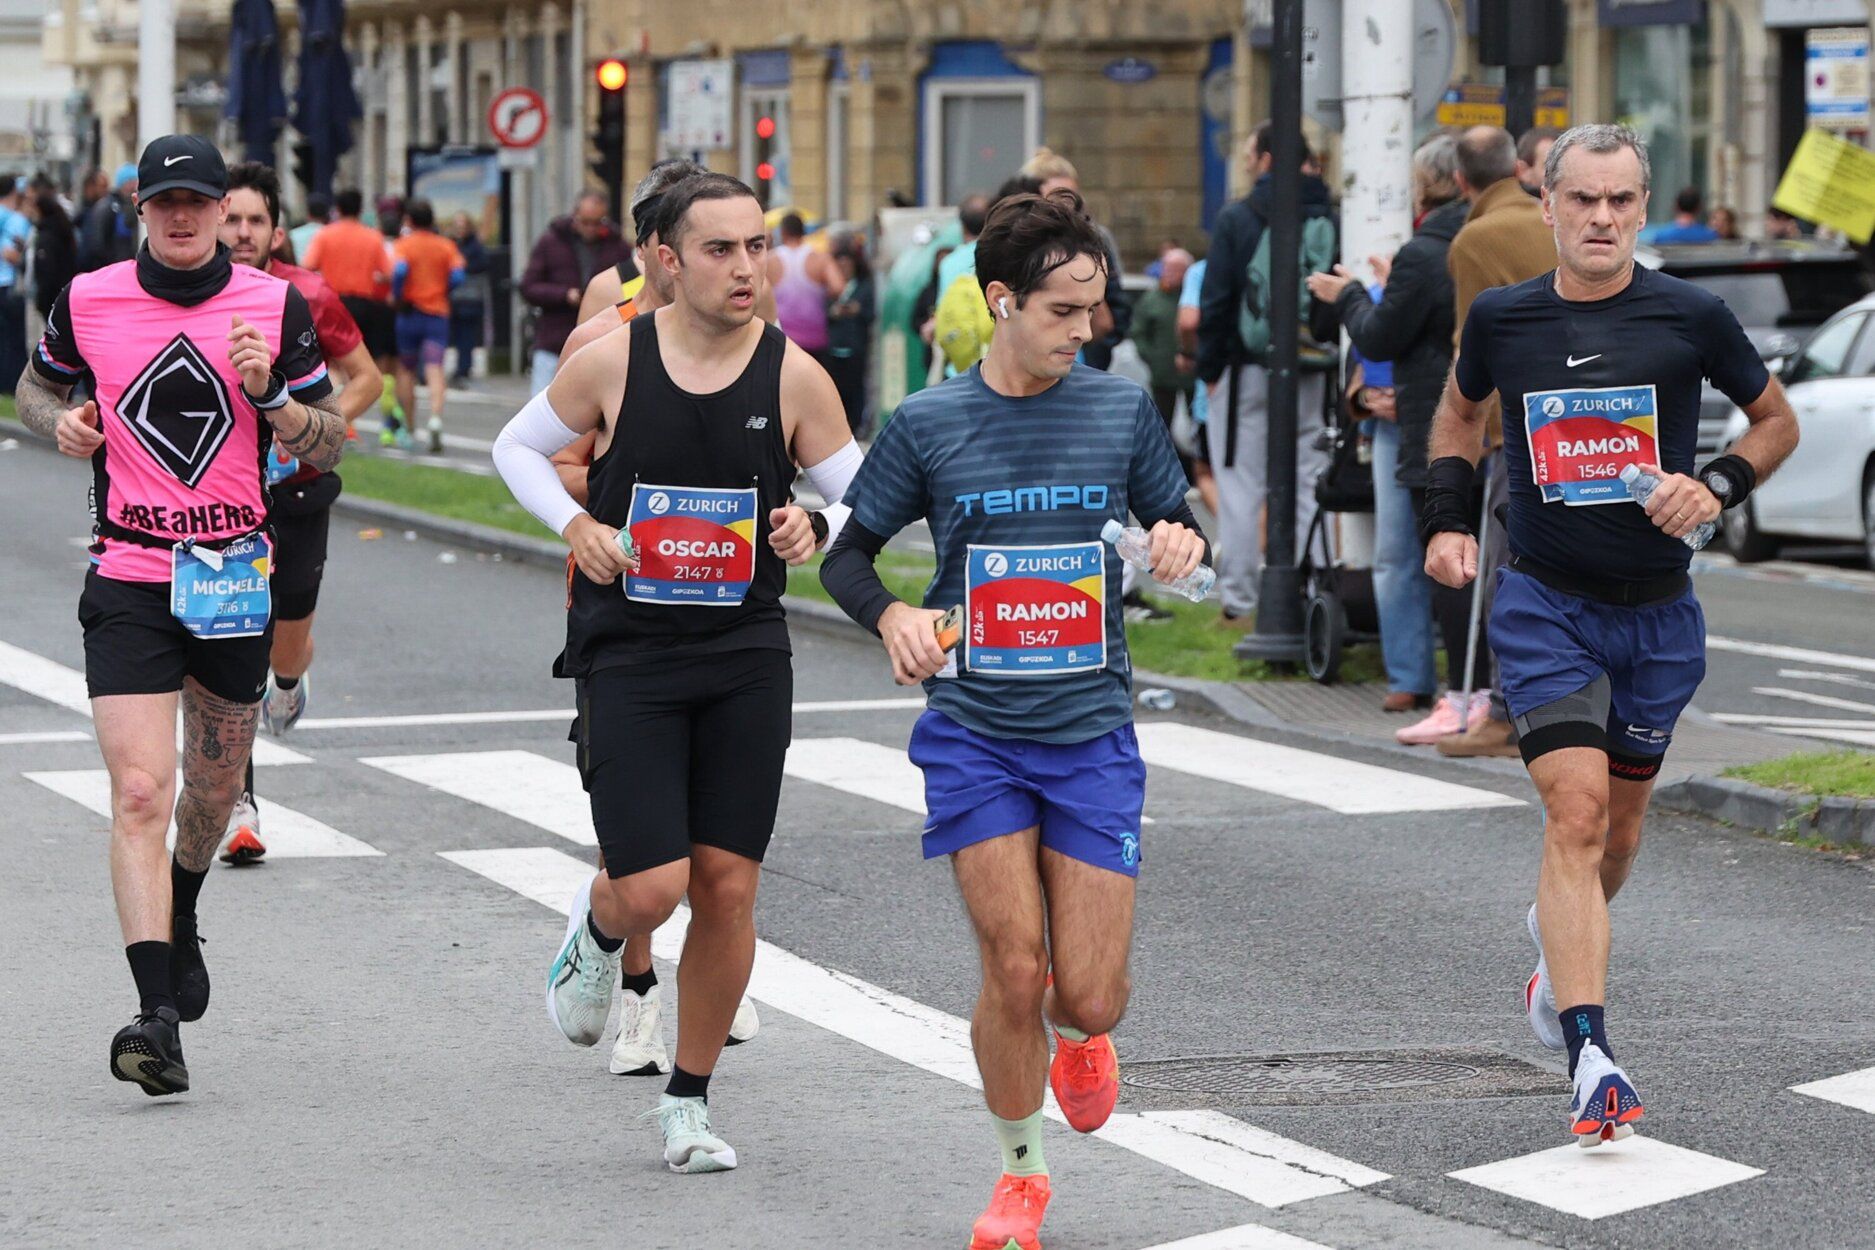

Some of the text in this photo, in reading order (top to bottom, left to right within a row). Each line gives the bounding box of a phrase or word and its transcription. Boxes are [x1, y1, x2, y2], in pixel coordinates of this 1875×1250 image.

[1572, 398, 1632, 412] ZURICH
[1557, 435, 1640, 458] RAMON
[1578, 462, 1617, 479] 1546
[677, 498, 738, 513] ZURICH
[658, 539, 736, 558] OSCAR
[674, 565, 711, 579] 2147
[1016, 556, 1082, 572] ZURICH
[193, 576, 266, 596] MICHELE
[996, 600, 1087, 622] RAMON
[973, 622, 984, 645] 42k
[1018, 629, 1059, 646] 1547
